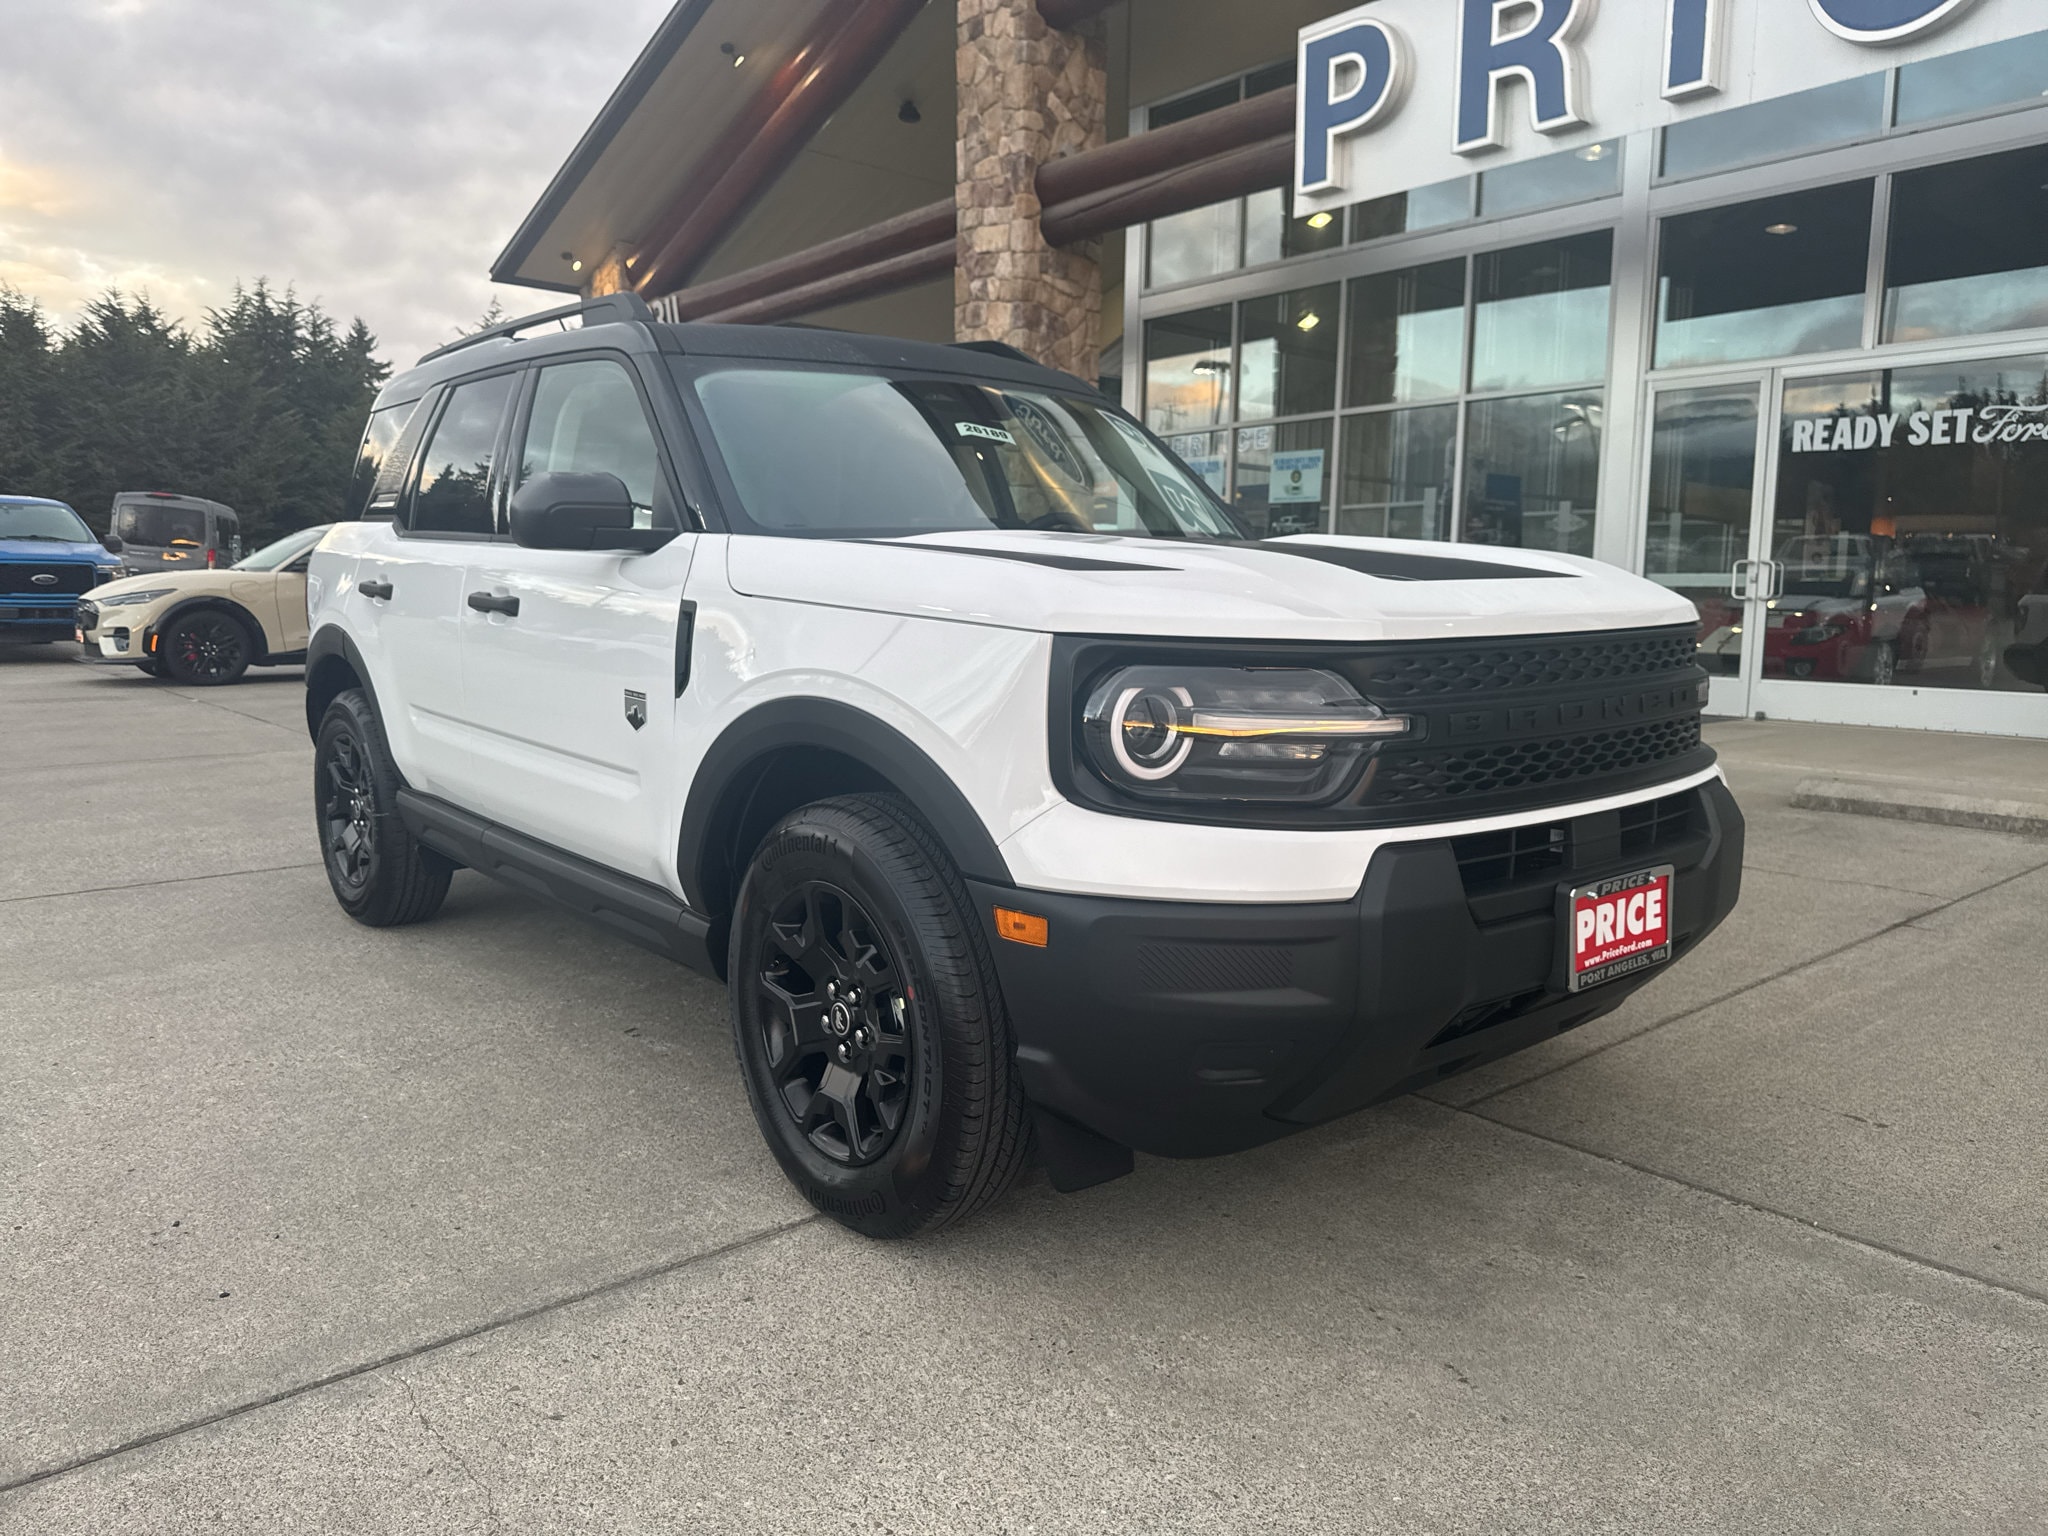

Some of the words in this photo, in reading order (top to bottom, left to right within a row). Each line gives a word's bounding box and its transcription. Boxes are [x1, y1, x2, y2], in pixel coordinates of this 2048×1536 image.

[963, 423, 1009, 440] 26189
[1792, 414, 1899, 452] READY
[1907, 408, 1973, 446] SET
[1449, 688, 1692, 735] BRONCO
[1601, 874, 1646, 896] PRICE
[1577, 888, 1662, 954] PRICE
[1580, 971, 1606, 987] PORT
[1607, 955, 1650, 977] ANGELES,
[1651, 948, 1666, 962] WA
[1584, 939, 1653, 968] www.PriceFord.com
